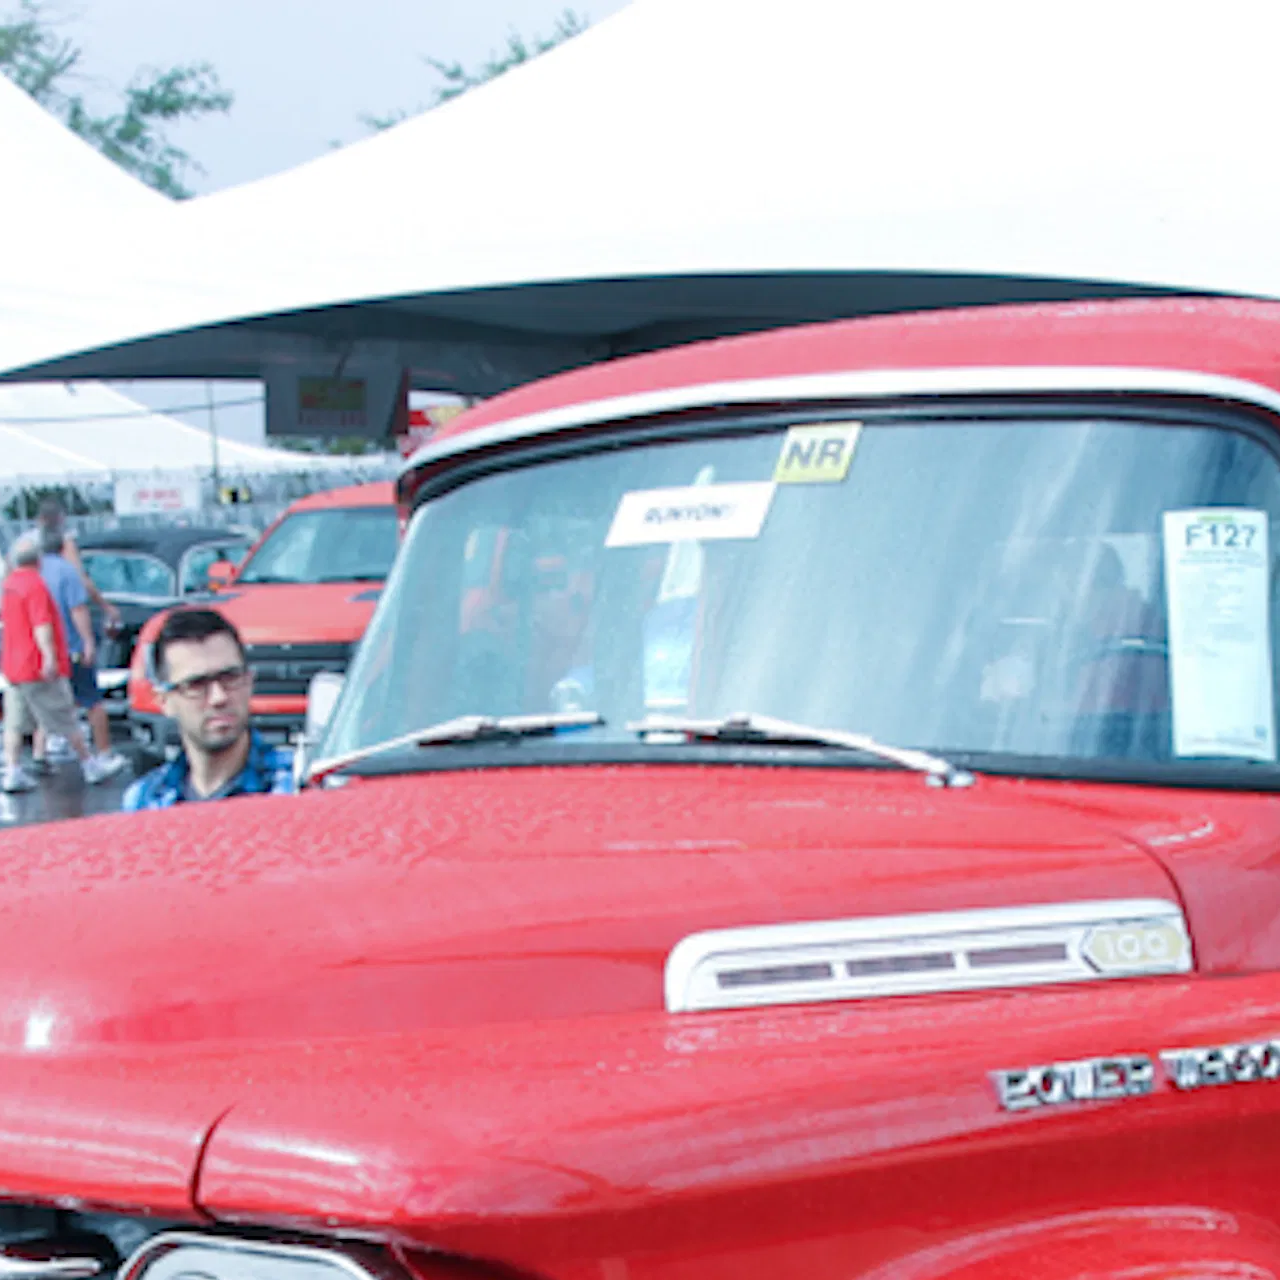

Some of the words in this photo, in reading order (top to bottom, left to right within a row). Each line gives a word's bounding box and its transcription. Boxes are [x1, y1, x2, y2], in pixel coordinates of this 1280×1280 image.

[784, 438, 845, 470] NR
[1185, 523, 1257, 549] F127
[1101, 931, 1169, 961] 100
[987, 1054, 1157, 1112] POWER
